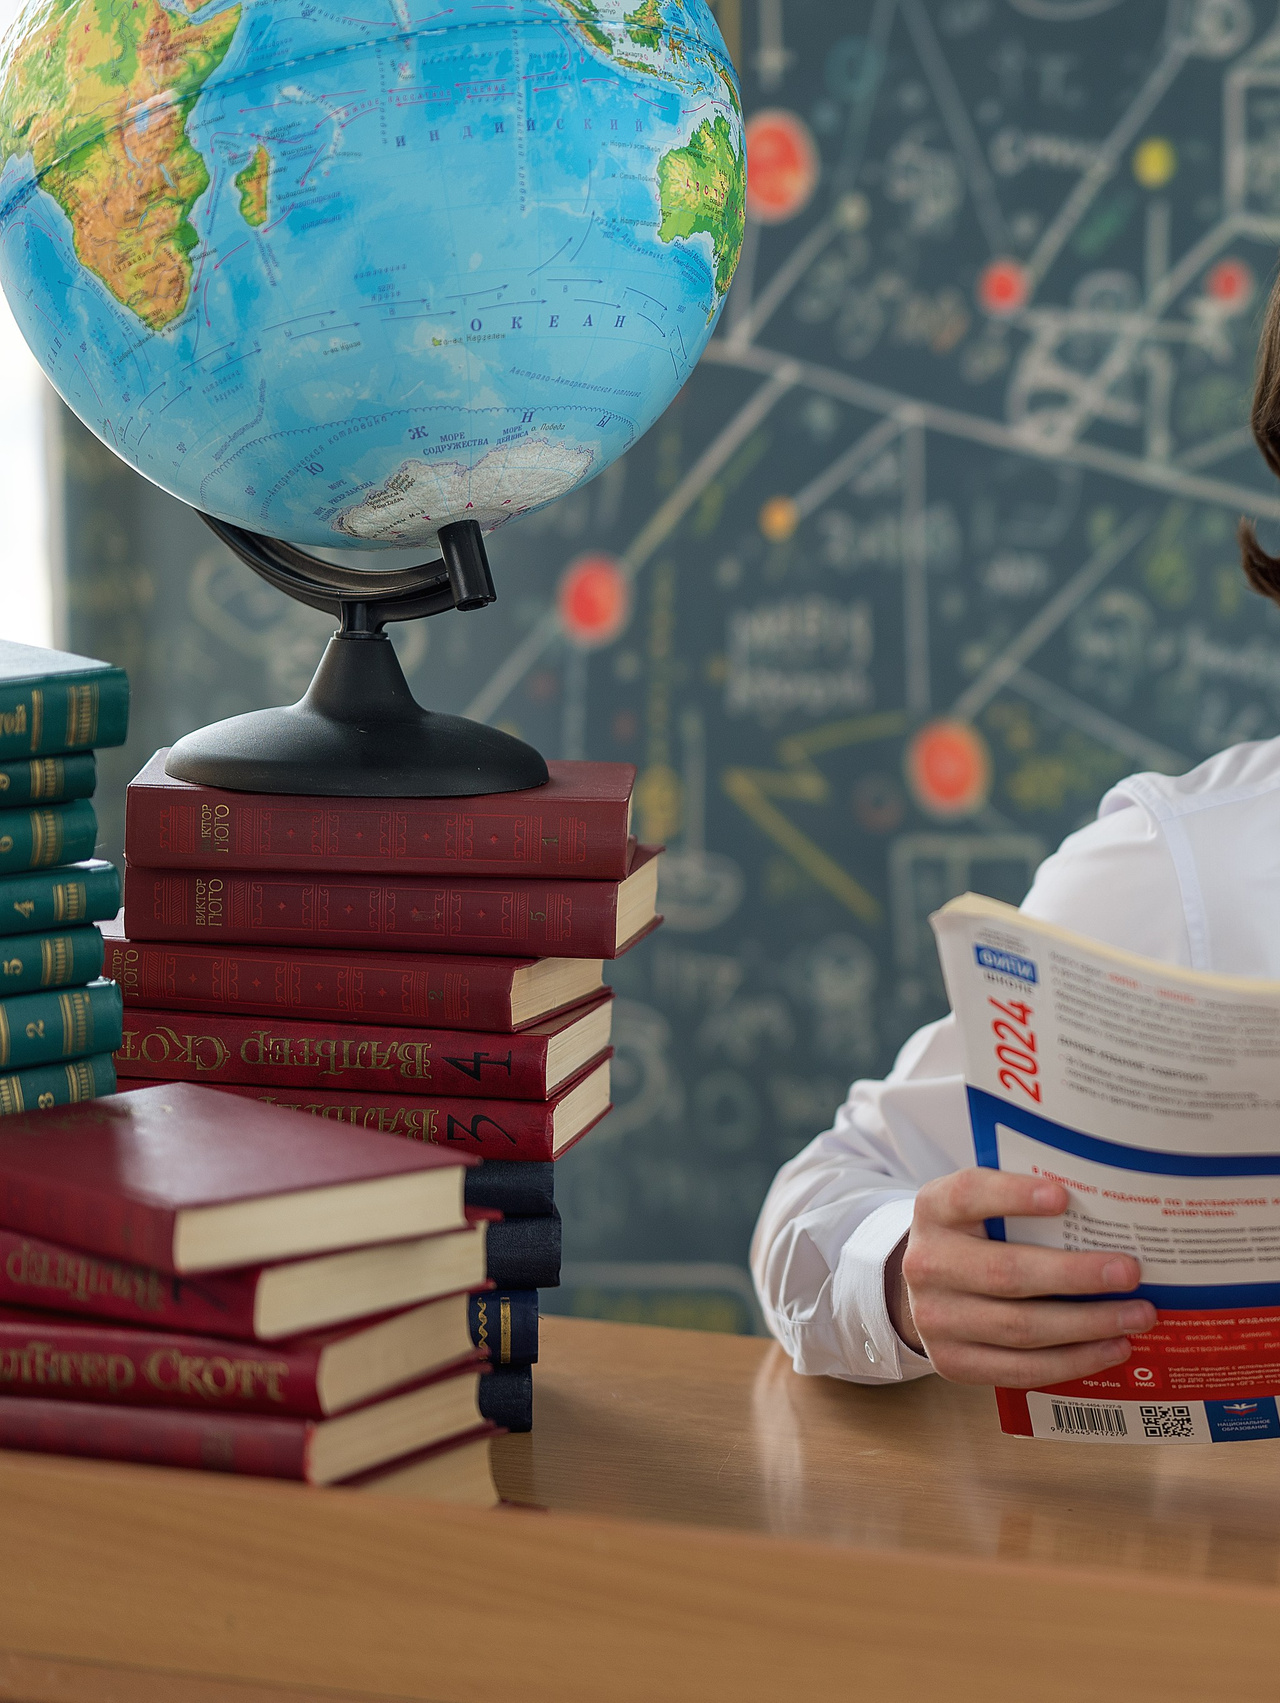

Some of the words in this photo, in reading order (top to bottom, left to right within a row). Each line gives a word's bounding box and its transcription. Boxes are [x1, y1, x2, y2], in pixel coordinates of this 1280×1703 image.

[395, 116, 644, 148] ИНДИЙСКИЙ
[470, 313, 627, 332] ОКЕАН
[439, 431, 466, 443] МОРЕ
[496, 429, 530, 445] ДЕЙВИСА
[502, 424, 524, 436] МОРЕ
[422, 437, 490, 457] СОДРУЖЕСТВА
[214, 803, 231, 854] ГЮГО
[541, 835, 559, 846] 1
[13, 899, 35, 919] 4
[196, 878, 207, 927] ВИКТОР
[208, 877, 225, 927] ГЮГО
[530, 910, 547, 922] 5
[3, 958, 24, 976] 5
[123, 949, 139, 997] ГЮГО
[428, 989, 444, 1001] 2
[26, 1019, 46, 1039] 2
[112, 1025, 231, 1071] СКОТ
[987, 996, 1042, 1104] 2024
[441, 1045, 513, 1082] 4
[38, 1091, 55, 1109] 3
[446, 1113, 517, 1147] 3
[1165, 1343, 1248, 1353] ОБЩЕСТВОЗНАНИЕ
[0, 1341, 137, 1393] ЛЬТЕР
[1082, 1379, 1121, 1388] oge.plus
[1216, 1418, 1271, 1428] НАЦИОНАЛЬНОЕ
[1221, 1424, 1269, 1432] ОБРАЗОВАНИЕ
